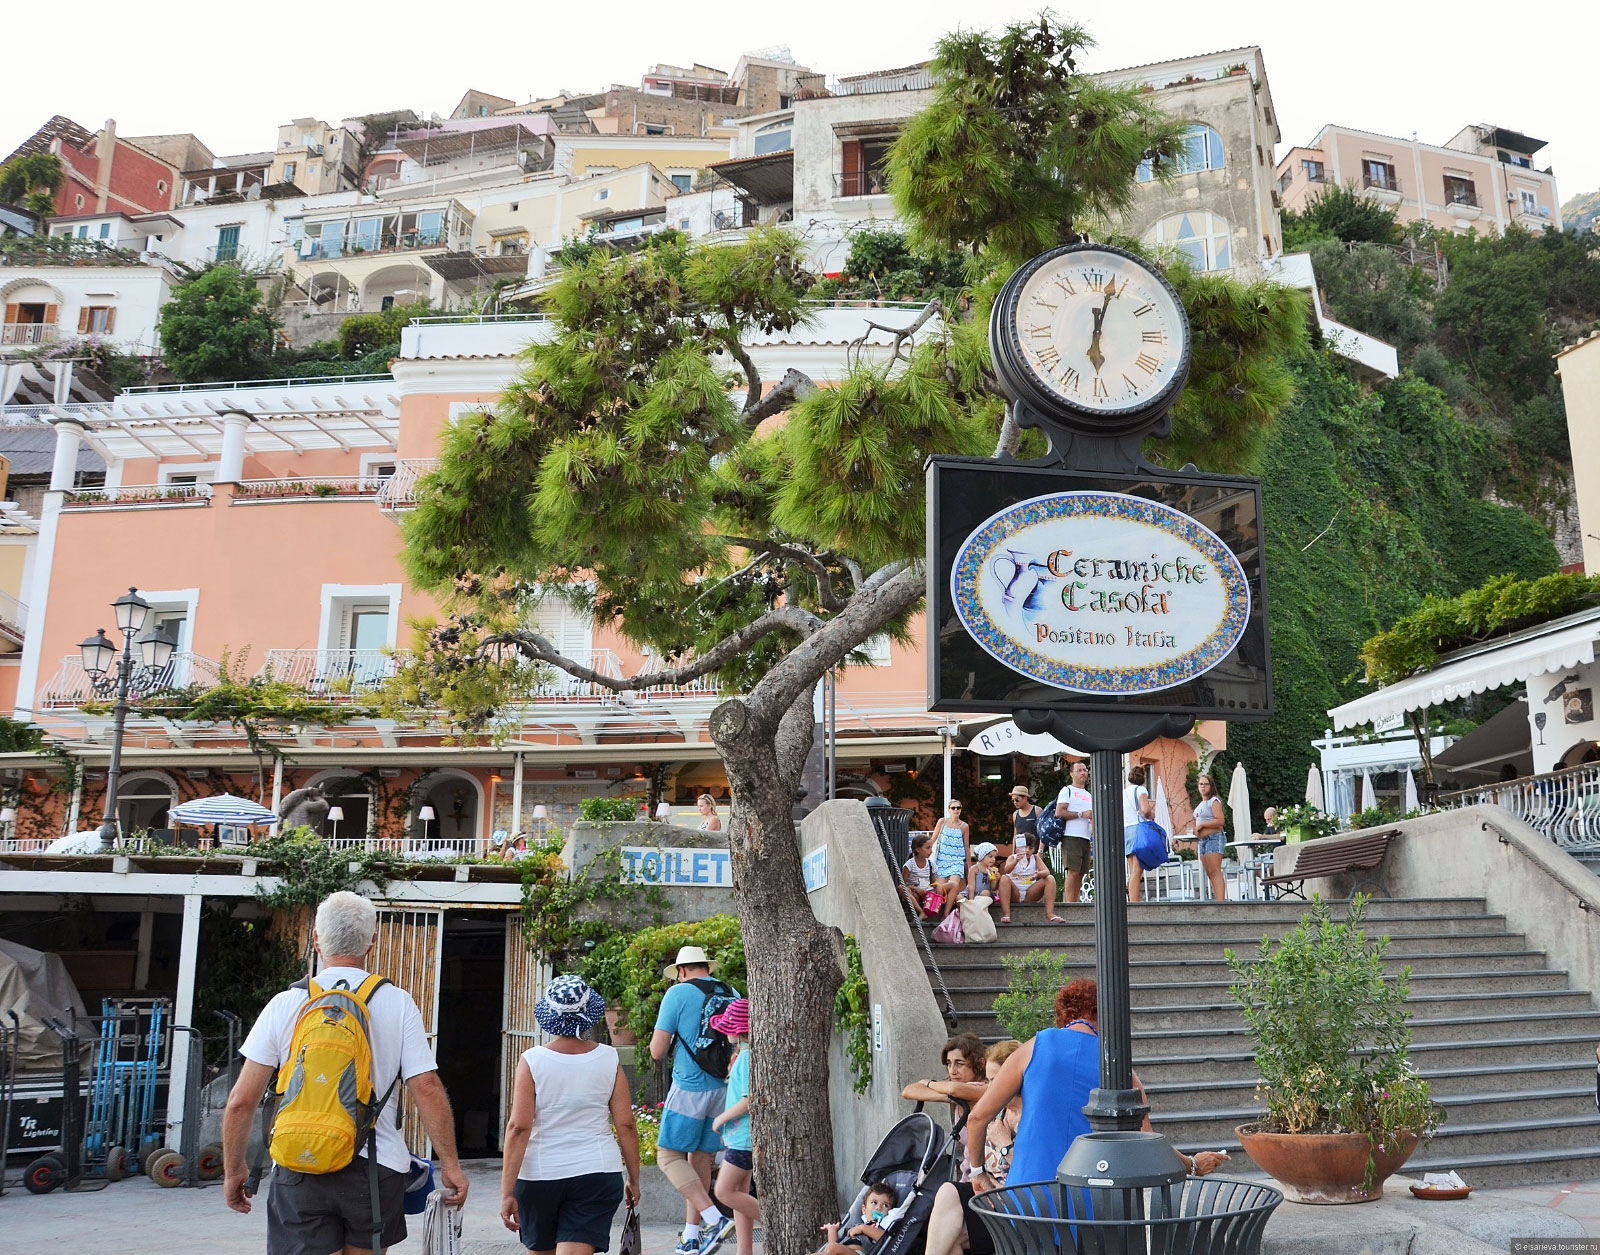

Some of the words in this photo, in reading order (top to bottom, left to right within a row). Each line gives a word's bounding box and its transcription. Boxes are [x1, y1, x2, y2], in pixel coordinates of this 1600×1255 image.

[1055, 276, 1077, 299] XI
[1082, 273, 1104, 293] XII
[1036, 297, 1058, 316] X
[1132, 302, 1153, 318] II
[1031, 322, 1051, 339] IX
[1142, 330, 1162, 345] III
[1093, 377, 1109, 397] VI
[1047, 549, 1208, 584] Ceramiche
[1061, 580, 1170, 615] Casola
[1034, 622, 1116, 646] Positano
[1124, 625, 1177, 649] Italia
[623, 851, 730, 884] TOILET
[23, 1127, 59, 1138] Lighting
